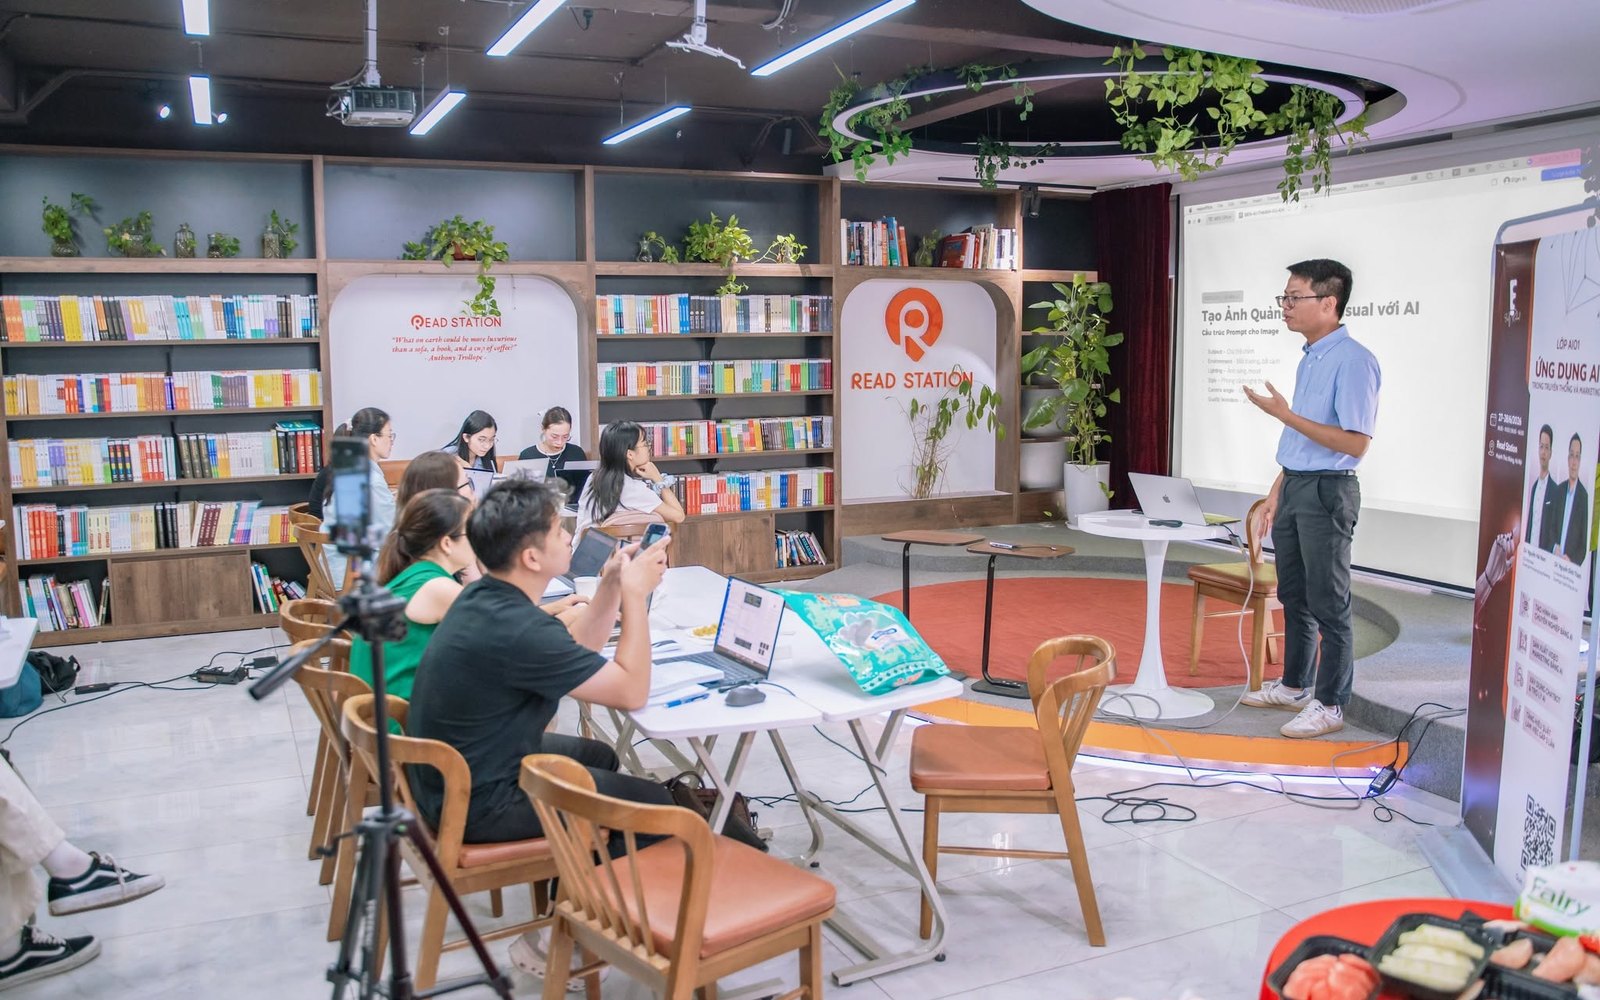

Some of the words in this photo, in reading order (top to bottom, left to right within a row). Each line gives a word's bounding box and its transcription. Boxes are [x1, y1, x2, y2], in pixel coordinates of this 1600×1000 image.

[1202, 310, 1222, 325] Tạo
[1224, 305, 1248, 321] Ảnh
[1377, 300, 1400, 316] với
[1403, 301, 1420, 315] AI
[410, 314, 448, 330] READ
[451, 315, 503, 328] STATION
[1226, 328, 1247, 337] Prompt
[1248, 327, 1260, 335] cho
[1260, 328, 1279, 337] Image
[414, 346, 429, 354] sofa,
[436, 345, 453, 353] book,
[458, 354, 483, 362] Trollope
[1535, 355, 1555, 379] ỨNG
[1557, 361, 1587, 385] DỤNG
[1589, 364, 1600, 383] AI
[851, 372, 897, 390] READ
[903, 371, 974, 390] STATION
[1531, 876, 1591, 917] Fairy
